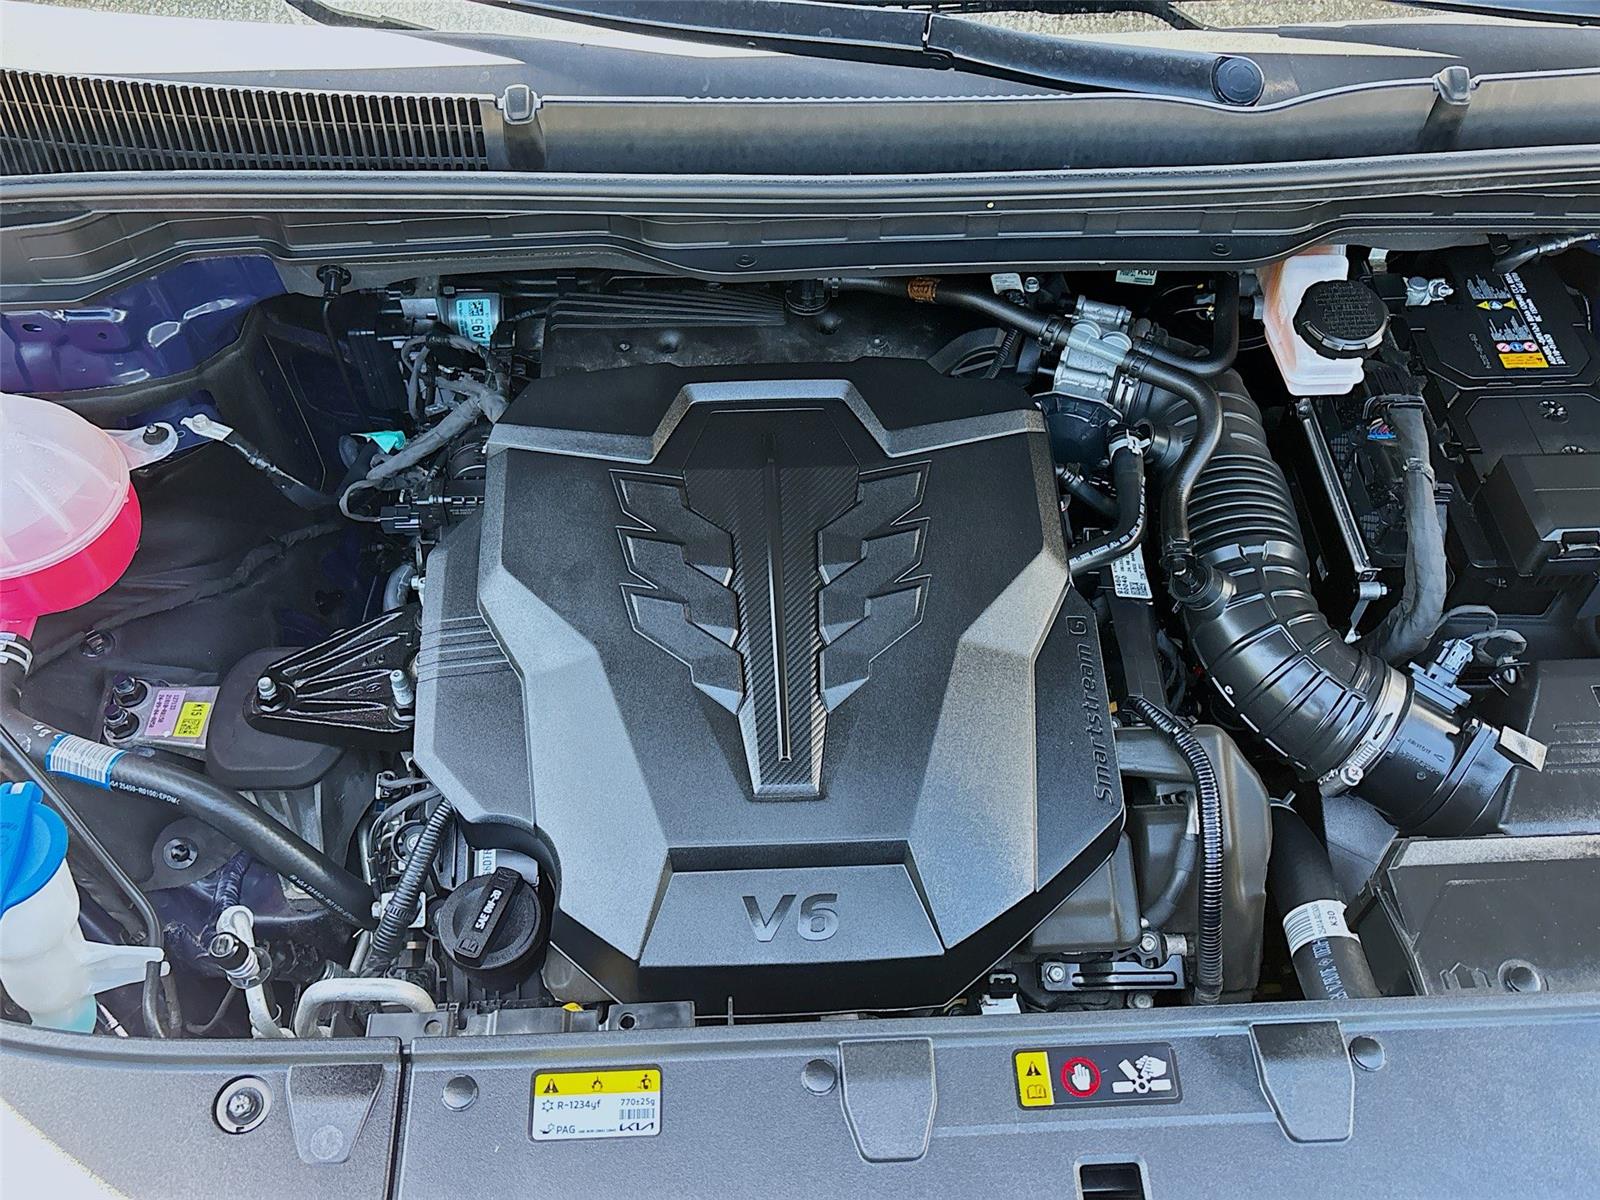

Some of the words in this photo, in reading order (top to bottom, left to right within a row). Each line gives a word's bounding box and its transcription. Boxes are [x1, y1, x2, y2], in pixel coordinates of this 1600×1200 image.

[471, 318, 487, 339] A95
[190, 703, 205, 716] K15
[1077, 641, 1114, 806] Smartstream
[475, 912, 489, 930] SAE
[485, 889, 503, 914] 0W-20
[742, 893, 839, 942] V6
[1326, 910, 1338, 927] K30
[557, 1099, 601, 1110] R-1234yf
[620, 1097, 656, 1107] 770±25g
[556, 1125, 576, 1134] PAG
[619, 1121, 655, 1132] KIA
